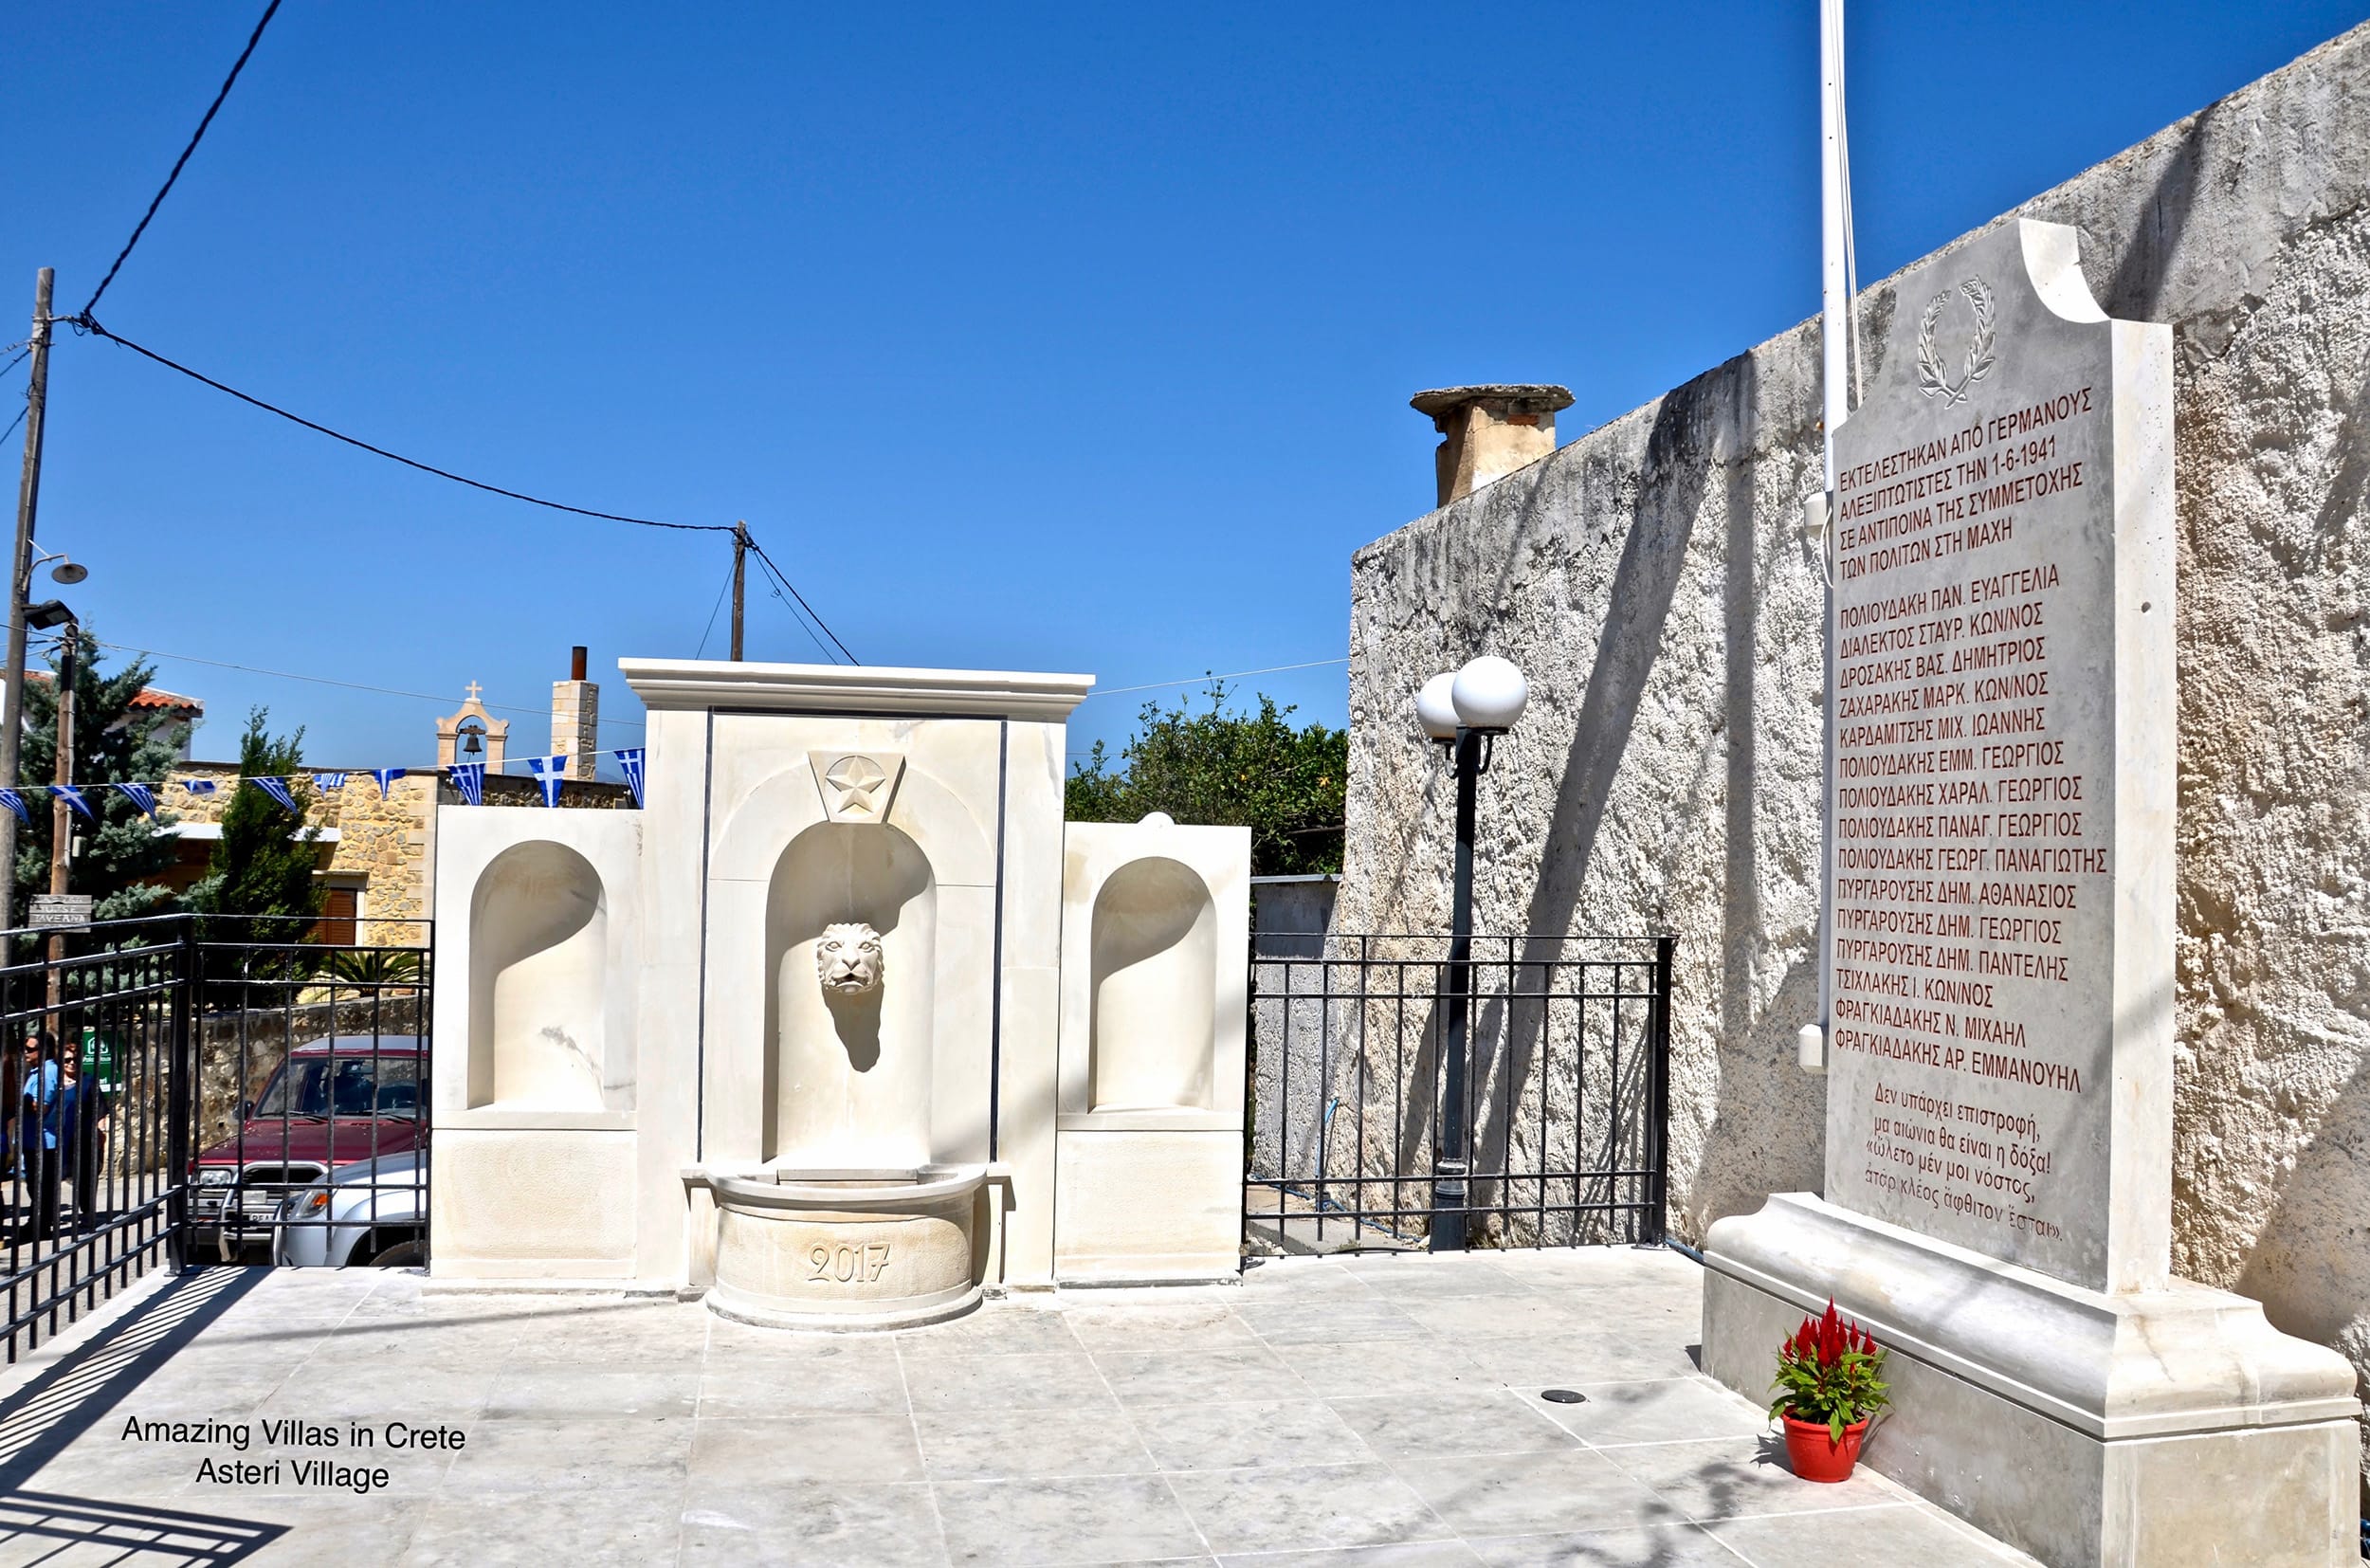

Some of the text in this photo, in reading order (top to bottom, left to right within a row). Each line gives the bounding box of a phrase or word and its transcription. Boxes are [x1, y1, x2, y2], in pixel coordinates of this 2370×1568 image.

[1840, 387, 2091, 492] ΕΚΤΕΛΕΣΤΗΚΑΝ ΑΠΟ ΓΕΡΜΑΝΟΥΣ
[1840, 434, 2055, 522] ΑΛΕΞΙΠΤΩΤΙΣΤΕΣ ΤΗΝ 1-6-1941
[1840, 462, 2083, 551] ΣΕ ΑΝΤΙΠΟΙΝΑ ΤΗΣ ΣΥΜΜΕΤΟΧΗΣ
[1840, 516, 2012, 580] ΤΩΝ ΠΟΛΙΤΩΝ ΣΤΗ ΜΑΧΗ
[1841, 564, 2059, 629] ΠΟΛΙΟΥΔΑΚΗ ΠΑΝ. ΕΥΑΓΓΕΛΙΑ
[1840, 602, 2043, 659] ΔΙΑΛΕΚΤΟΣ ΣΤΑΥΡ. ΚΩΝ/ΝΟΣ
[1840, 636, 2046, 689] ΔΡΟΣΑΚΗΣ ΒΑΣ. ΔΗΜΗΤΡΙΟΣ
[1840, 671, 2049, 718] ΖΑΧΑΡΑΚΗΣ ΜΑΡΚ. ΚΩΝ/ΝΟΣ
[1840, 707, 2045, 748] ΚΑΡΔΑΜΙΤΣΗΣ ΜΙΧ. ΙΩΑΝΝΗΣ
[1840, 740, 2064, 778] ΠΟΛΙΟΥΔΑΚΗΣ ΕΜΜ. ΓΕΩΡΓΙΟΣ
[1839, 775, 2082, 809] ΠΟΛΙΟΥΔΑΚΗΣ ΧΑΡΑΛ. ΓΕΩΡΓΙΟΣ
[1839, 812, 2082, 838] ΠΟΛΙΟΥΔΑΚΗΣ ΠΑΝΑΓ. ΓΕΩΡΓΙΟΣ
[1839, 848, 2106, 873] ΠΟΛΙΟΥΔΑΚΗΣ ΓΕΩΡΓ. ΠΑΝΑΓΙΩΤΗΣ
[1838, 879, 2076, 909] ΠΥΡΓΑΡΟΥΣΗΣ ΔΗΜ. ΑΘΑΝΑΣΙΟΣ
[1838, 909, 2061, 944] ΠΥΡΓΑΡΟΥΣΗΣ ΔΗΜ. ΓΕΩΡΓΙΟΣ
[1837, 939, 2069, 981] ΠΥΡΓΑΡΟΥΣΗΣ ΔΗΜ. ΠΑΝΤΕΛΗΣ
[1836, 969, 1993, 1008] ΤΣΙΧΛΑΚΗΣ Ι. ΚΩΝ/ΝΟΣ
[1836, 997, 2026, 1048] ΦΡΑΓΚΙΑΔΑΚΗΣ Ν. ΜΙΧΑΗΛ
[1835, 1028, 2081, 1093] ΦΡΑΓΚΙΑΔΑΚΗΣ ΑΡ. ΕΜΜΑΝΟΥΗΛ
[1875, 1082, 2040, 1143] Δεν υπάρχει επιστροφή,
[1874, 1117, 2051, 1176] μα αιώνια θα είναι η δόξα!
[1919, 1152, 1942, 1174] μέν
[1946, 1161, 1969, 1181] μοι
[1975, 1166, 2034, 1203] νόστος,
[806, 1242, 890, 1283] 2017
